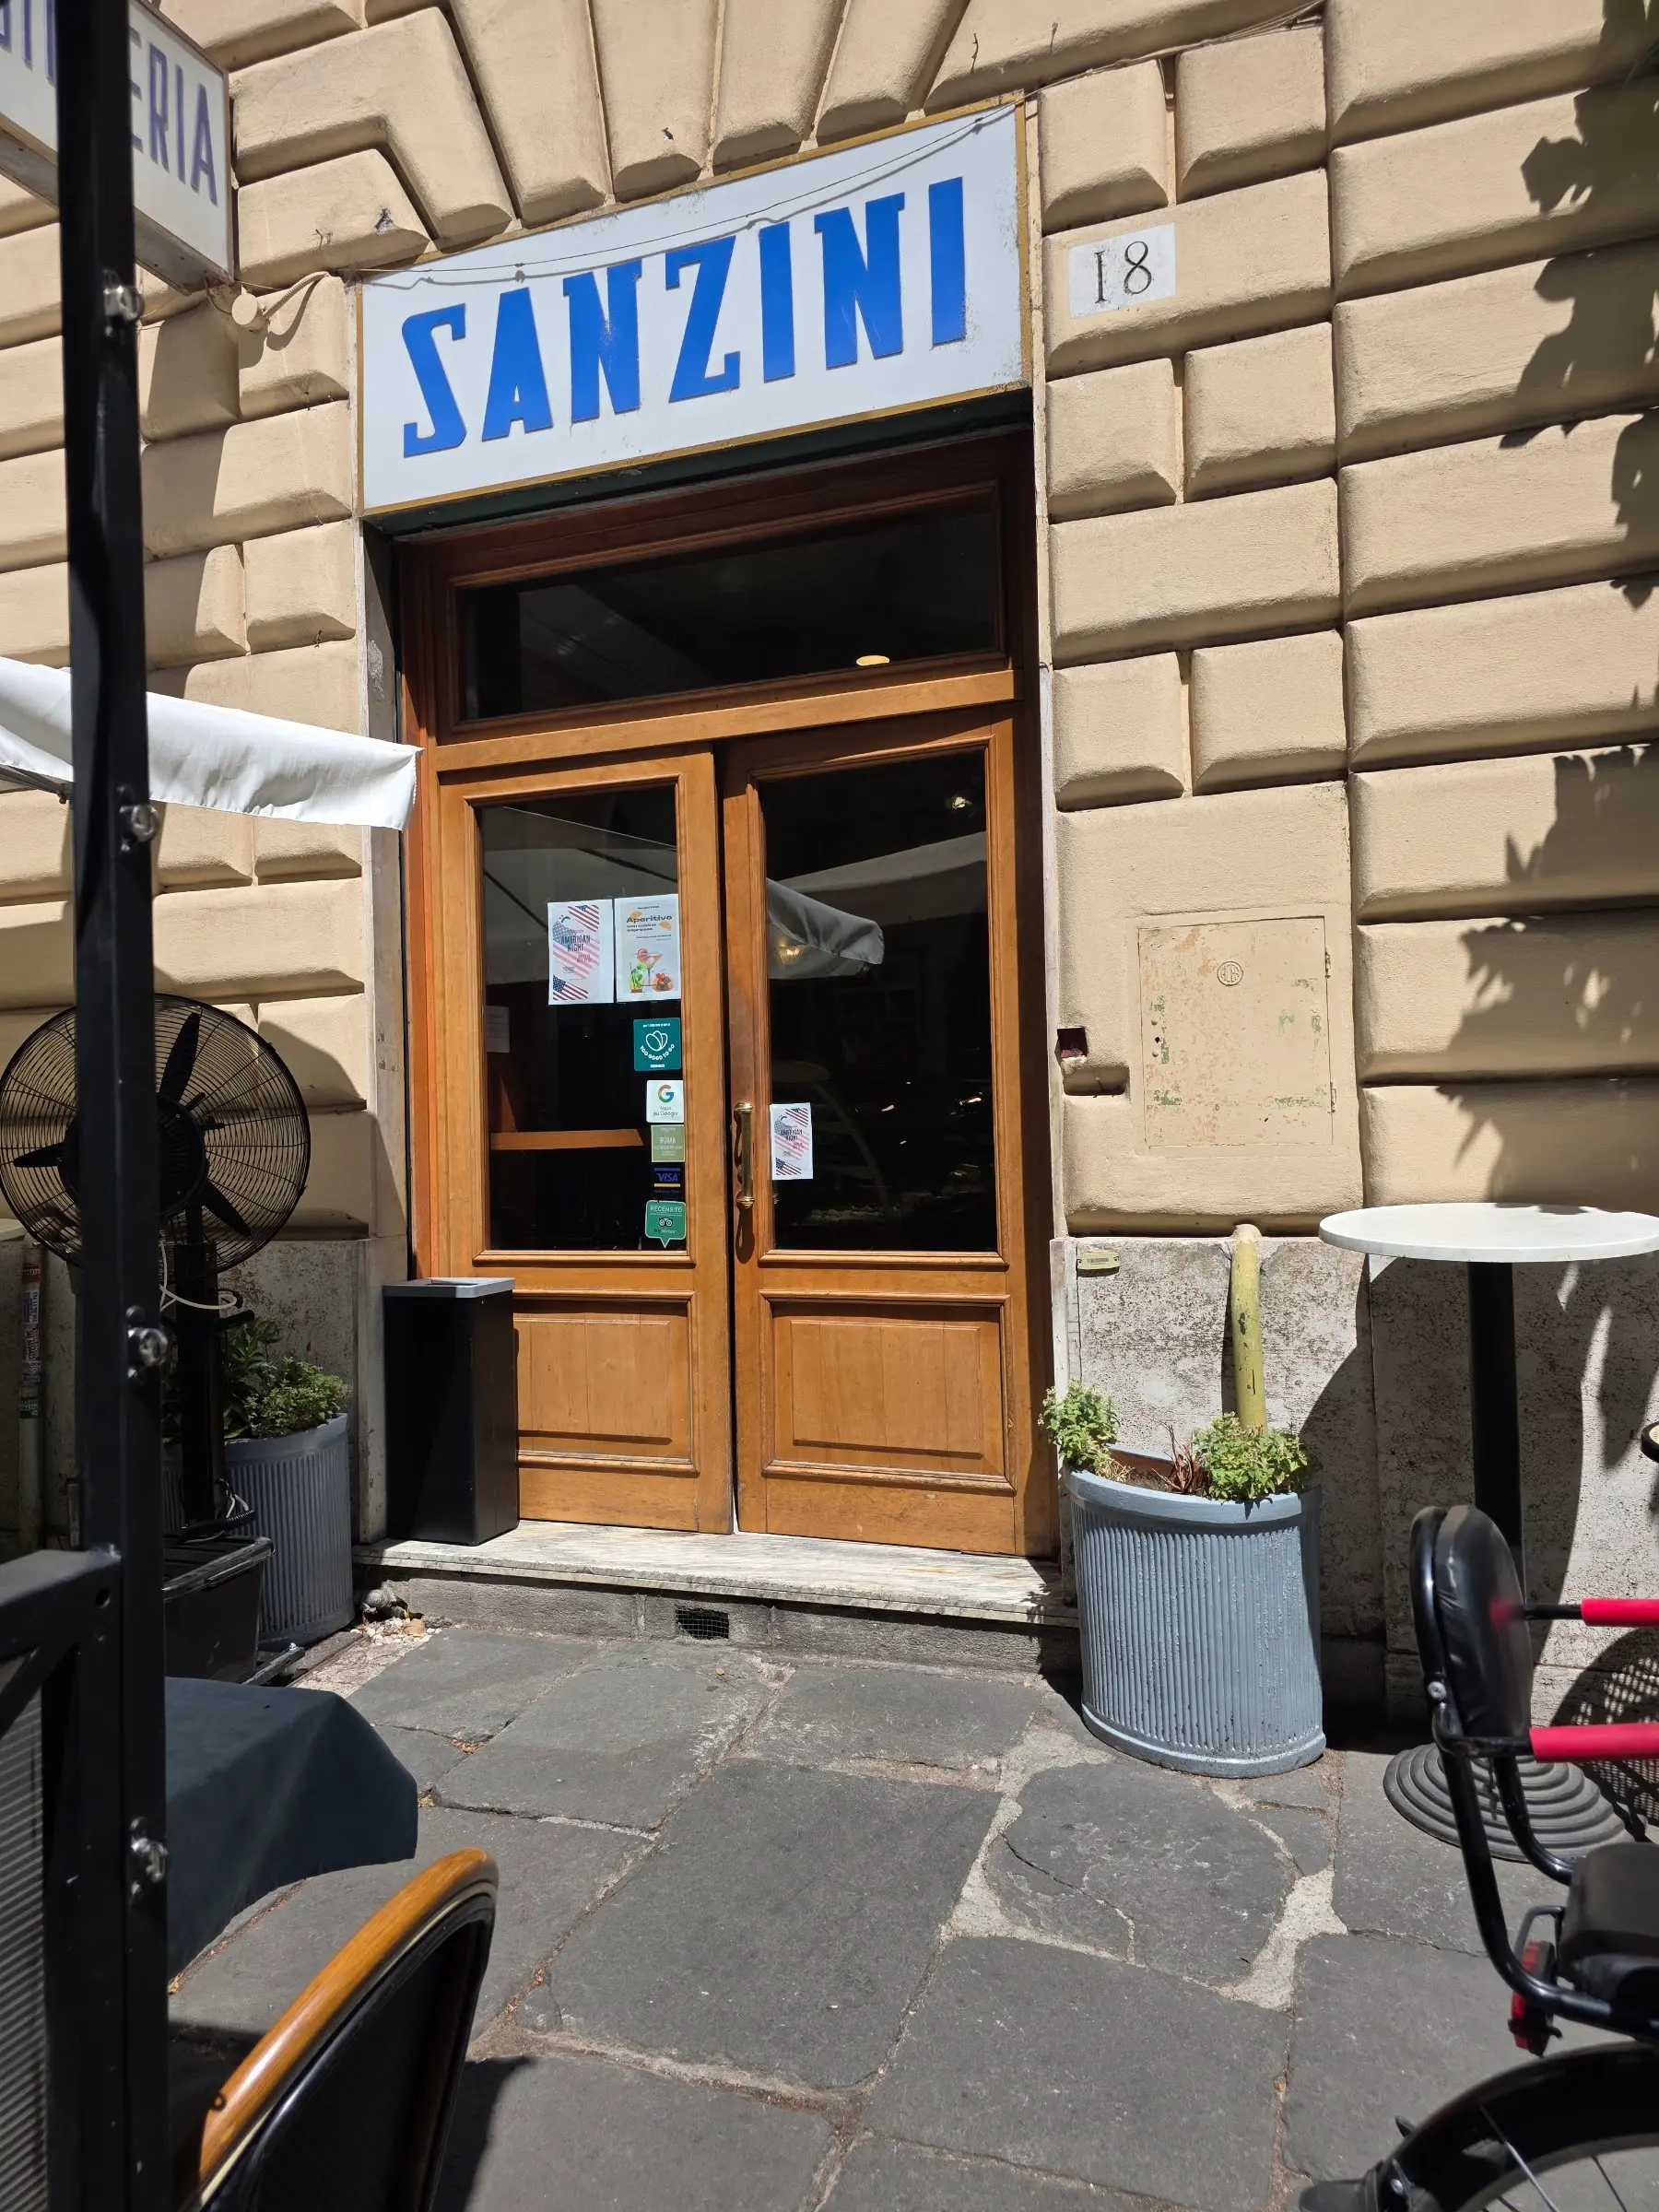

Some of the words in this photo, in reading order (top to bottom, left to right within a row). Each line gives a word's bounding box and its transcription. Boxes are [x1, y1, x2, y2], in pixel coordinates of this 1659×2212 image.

[1094, 241, 1152, 304] 18
[402, 176, 967, 457] SANZINI
[626, 914, 673, 924] Aperitivo
[560, 935, 591, 945] AMERICAN
[567, 943, 584, 952] NIGHT
[640, 1045, 649, 1056] TOO
[668, 1043, 675, 1053] GO
[660, 1110, 678, 1118] Google
[659, 1136, 677, 1145] ROMA
[657, 1172, 678, 1182] VISA
